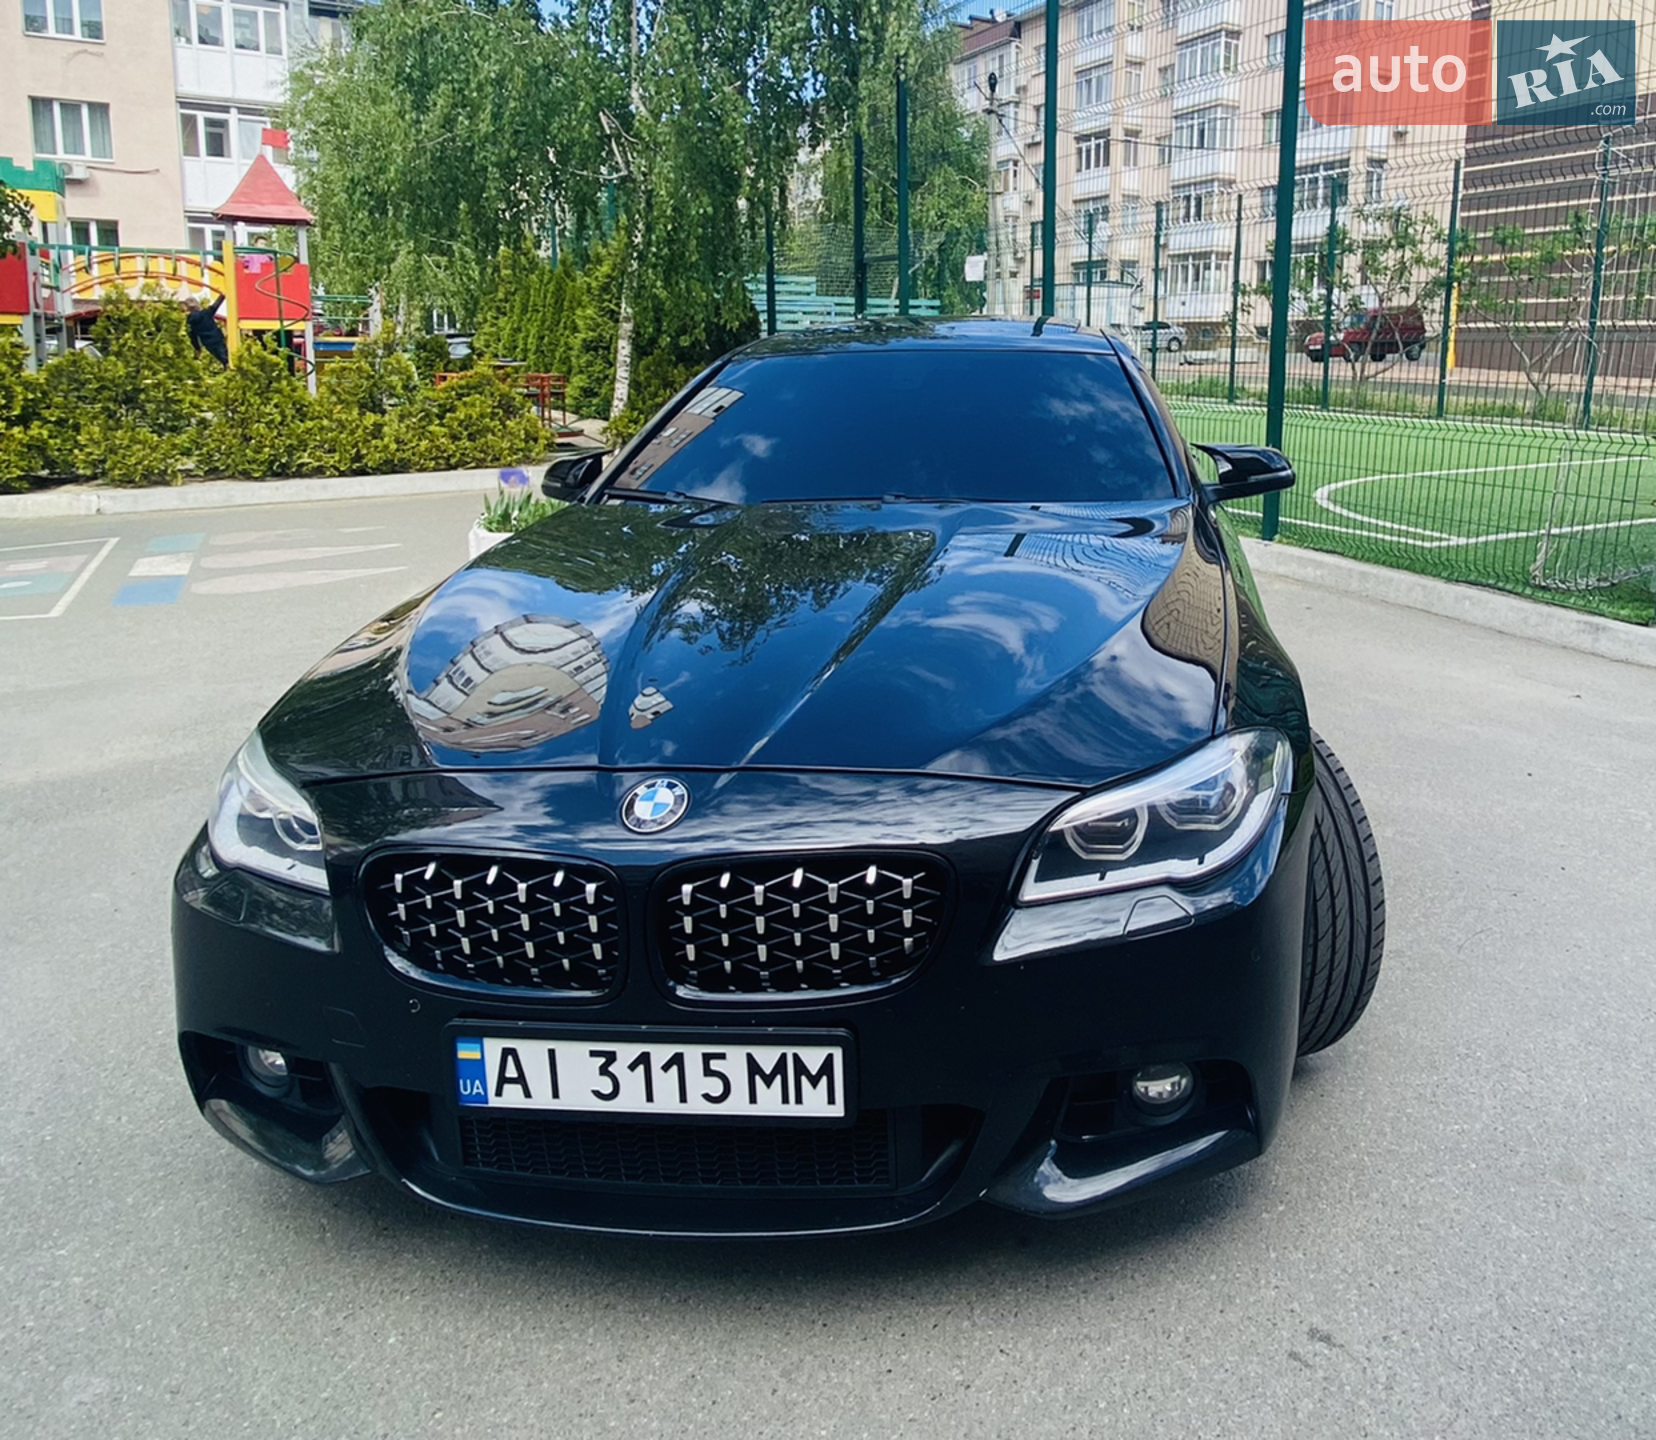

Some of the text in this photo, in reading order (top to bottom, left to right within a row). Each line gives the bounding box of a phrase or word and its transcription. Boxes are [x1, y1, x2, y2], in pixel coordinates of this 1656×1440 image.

[459, 1078, 485, 1096] UA
[494, 1046, 561, 1099] AI
[588, 1050, 732, 1104] 3115
